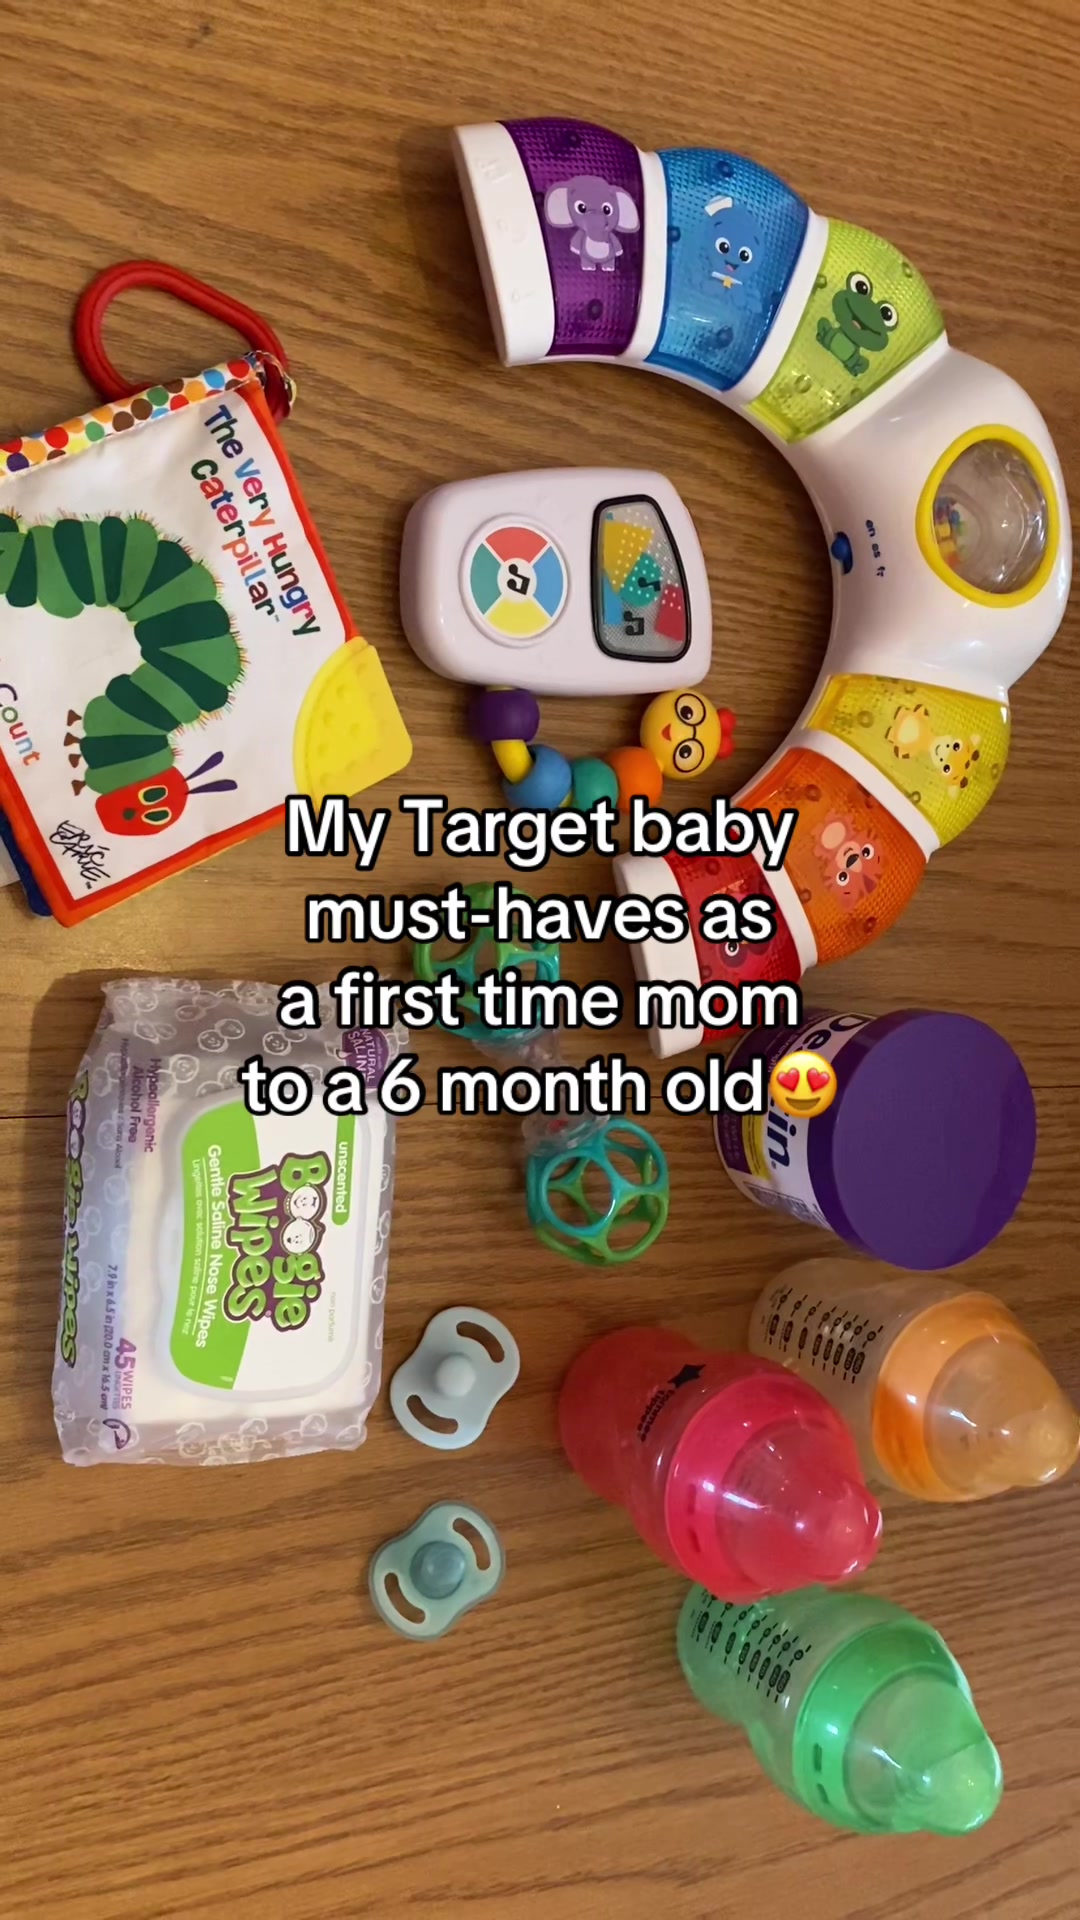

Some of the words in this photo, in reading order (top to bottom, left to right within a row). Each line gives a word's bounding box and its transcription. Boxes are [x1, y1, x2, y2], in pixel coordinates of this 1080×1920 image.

[204, 404, 243, 459] The
[262, 532, 321, 637] Hungry
[360, 1028, 377, 1083] NATURAL
[130, 1066, 144, 1112] Alcohol
[144, 1058, 162, 1153] Hypoallergenic
[128, 1116, 141, 1143] Free
[207, 1144, 225, 1197] Gentle
[335, 1141, 349, 1213] unscented
[210, 1201, 226, 1250] Saline
[226, 1173, 279, 1320] Wipes
[107, 1264, 118, 1279] 7.9
[206, 1254, 223, 1294] Nose
[195, 1299, 217, 1348] Wipes
[114, 1338, 137, 1369] 45
[121, 1370, 134, 1410] WIPES
